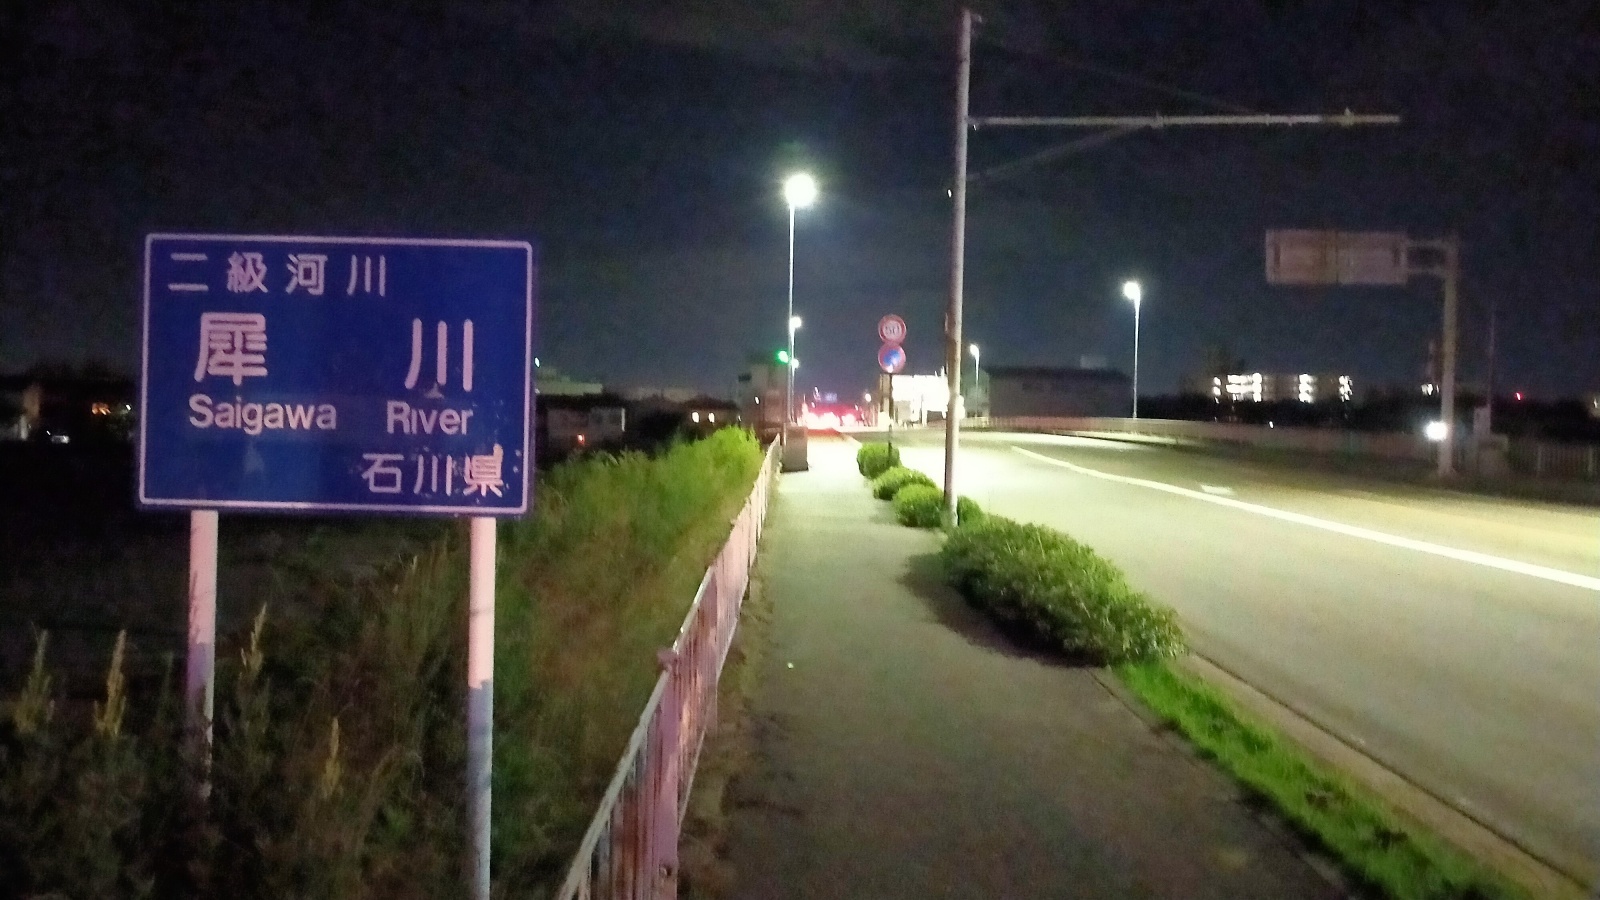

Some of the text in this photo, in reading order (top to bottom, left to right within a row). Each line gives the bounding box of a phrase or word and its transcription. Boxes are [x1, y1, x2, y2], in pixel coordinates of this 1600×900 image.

[168, 251, 387, 297] 二級河川
[189, 394, 474, 435] Saigawa River
[361, 445, 504, 497] 石川県
